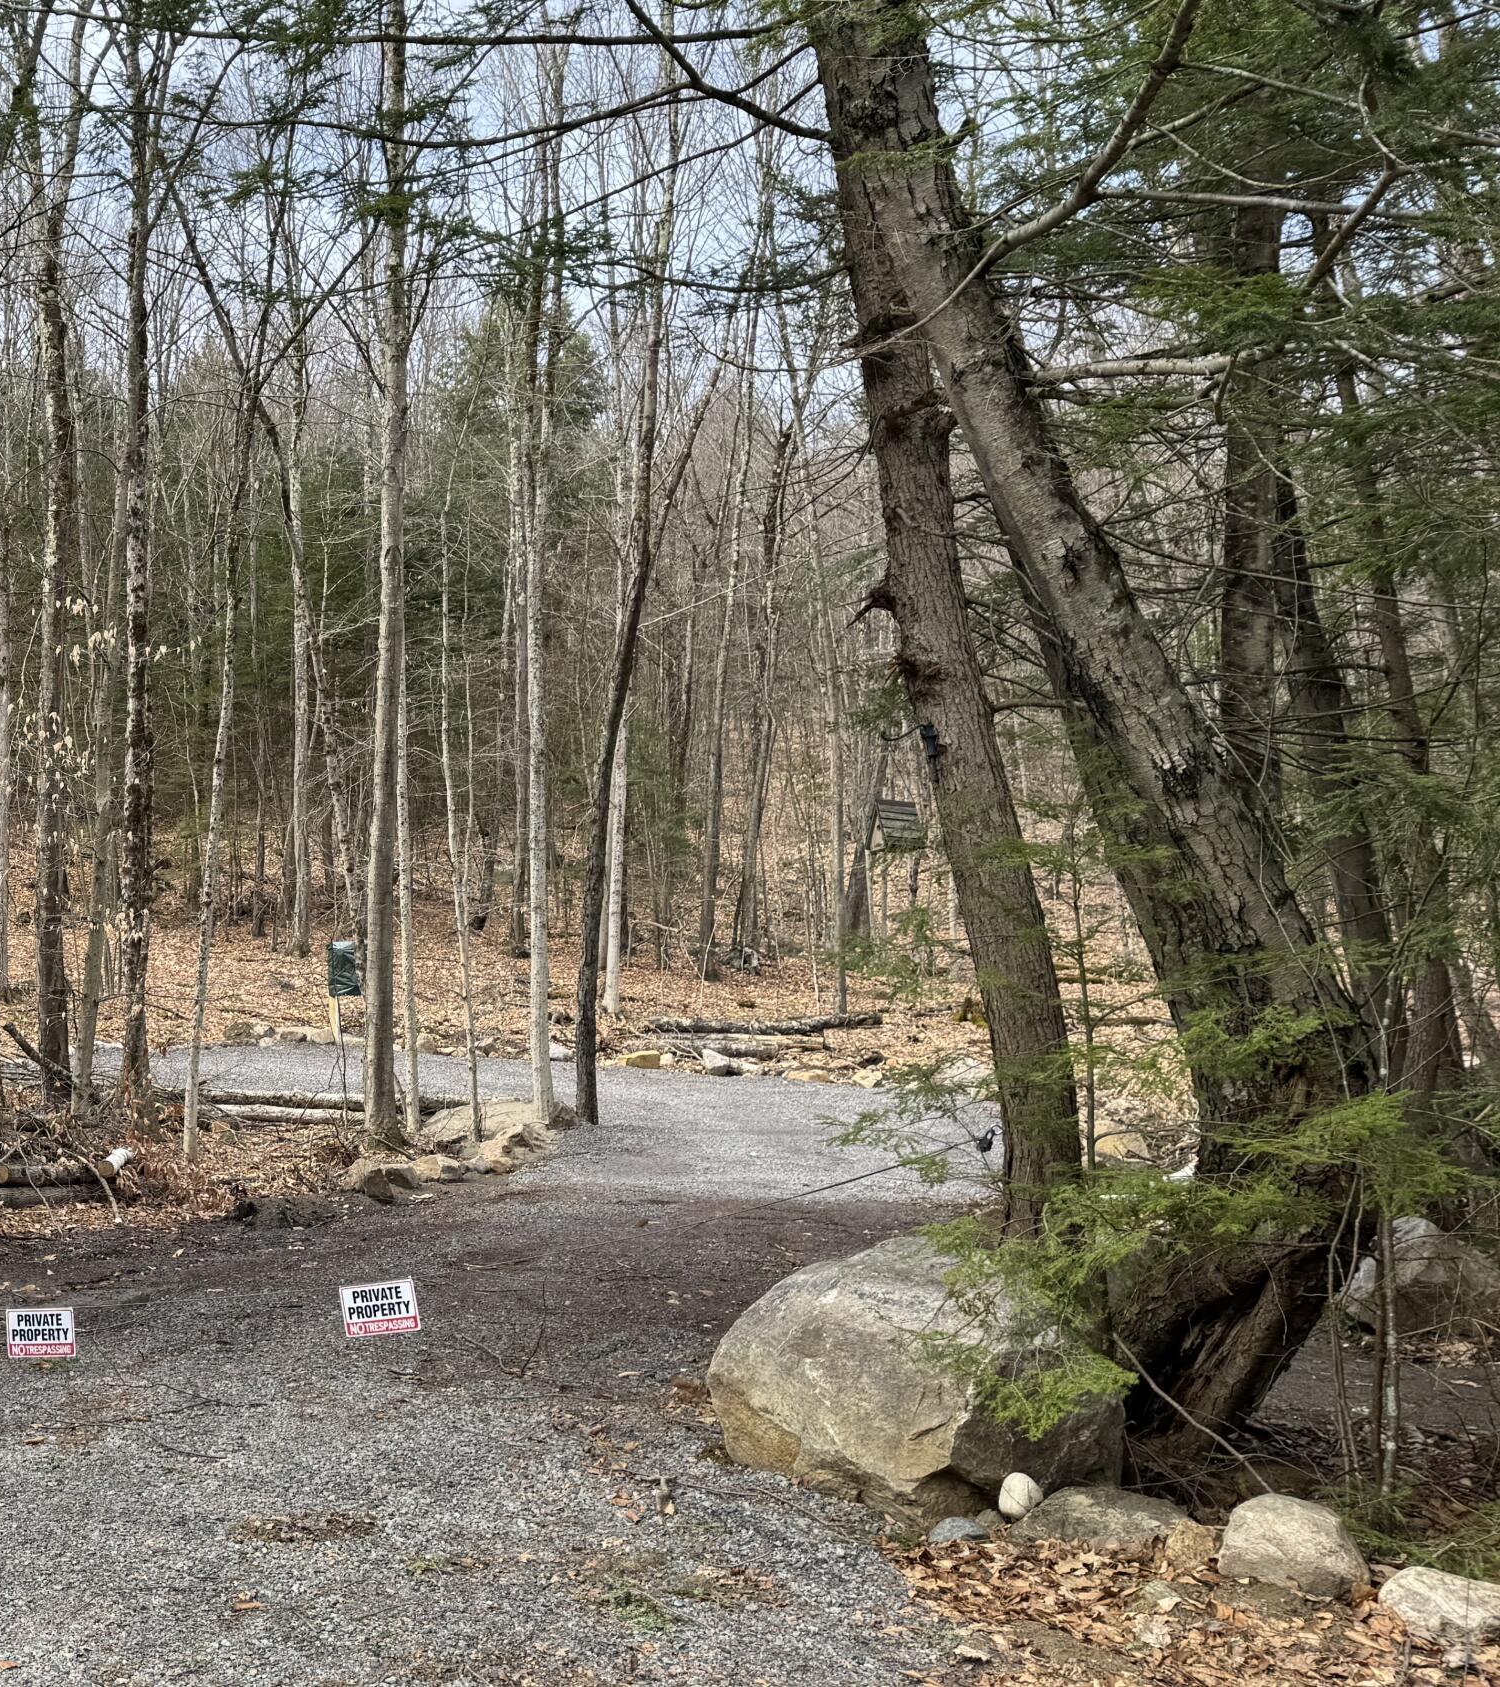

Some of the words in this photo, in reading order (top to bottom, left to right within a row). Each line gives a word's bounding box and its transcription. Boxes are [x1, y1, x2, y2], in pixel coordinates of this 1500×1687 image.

[352, 1286, 402, 1304] PRIVATE
[348, 1301, 410, 1320] PROPERTY
[17, 1313, 62, 1327] PRIVATE
[349, 1323, 365, 1334] NO
[365, 1318, 415, 1332] TRESPASSING
[11, 1328, 69, 1342] PROPERTY
[11, 1344, 26, 1355] NO
[26, 1345, 72, 1354] TRESPASSING
